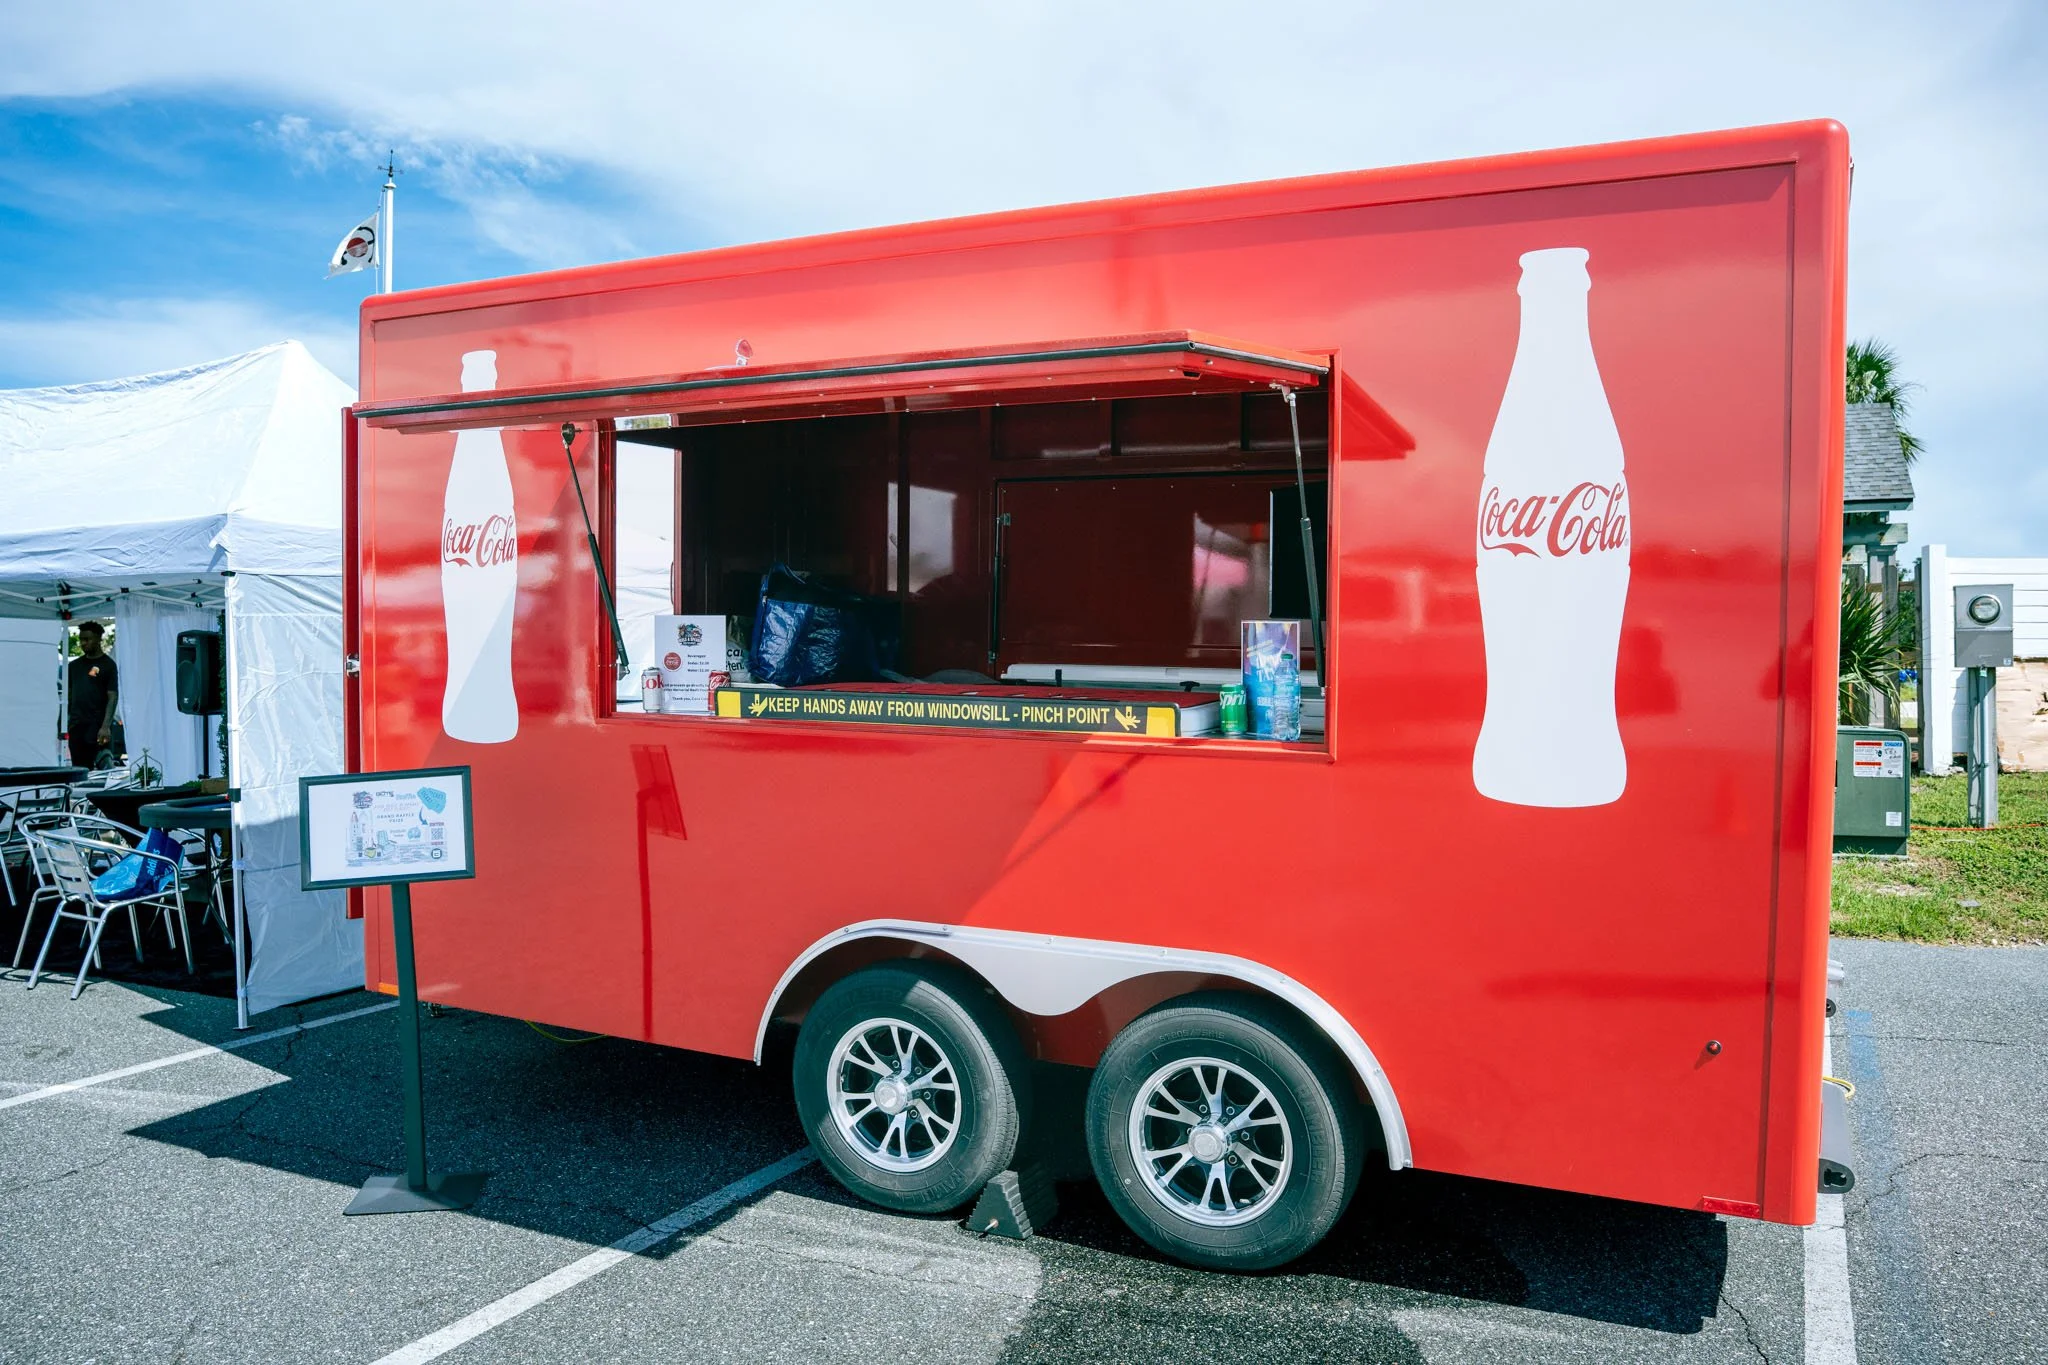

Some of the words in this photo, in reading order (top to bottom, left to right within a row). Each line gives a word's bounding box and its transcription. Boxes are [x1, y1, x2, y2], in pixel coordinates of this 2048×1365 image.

[442, 514, 515, 568] Coca-Cola
[1479, 482, 1627, 559] Coca-Cola
[768, 696, 800, 713] KEEP
[803, 698, 846, 715] HANDS
[849, 700, 883, 716] AWAY
[887, 701, 925, 718] FROM
[927, 702, 1010, 722] WINDOWSILL
[1021, 706, 1062, 723] PINCH
[1067, 707, 1110, 725] POINT
